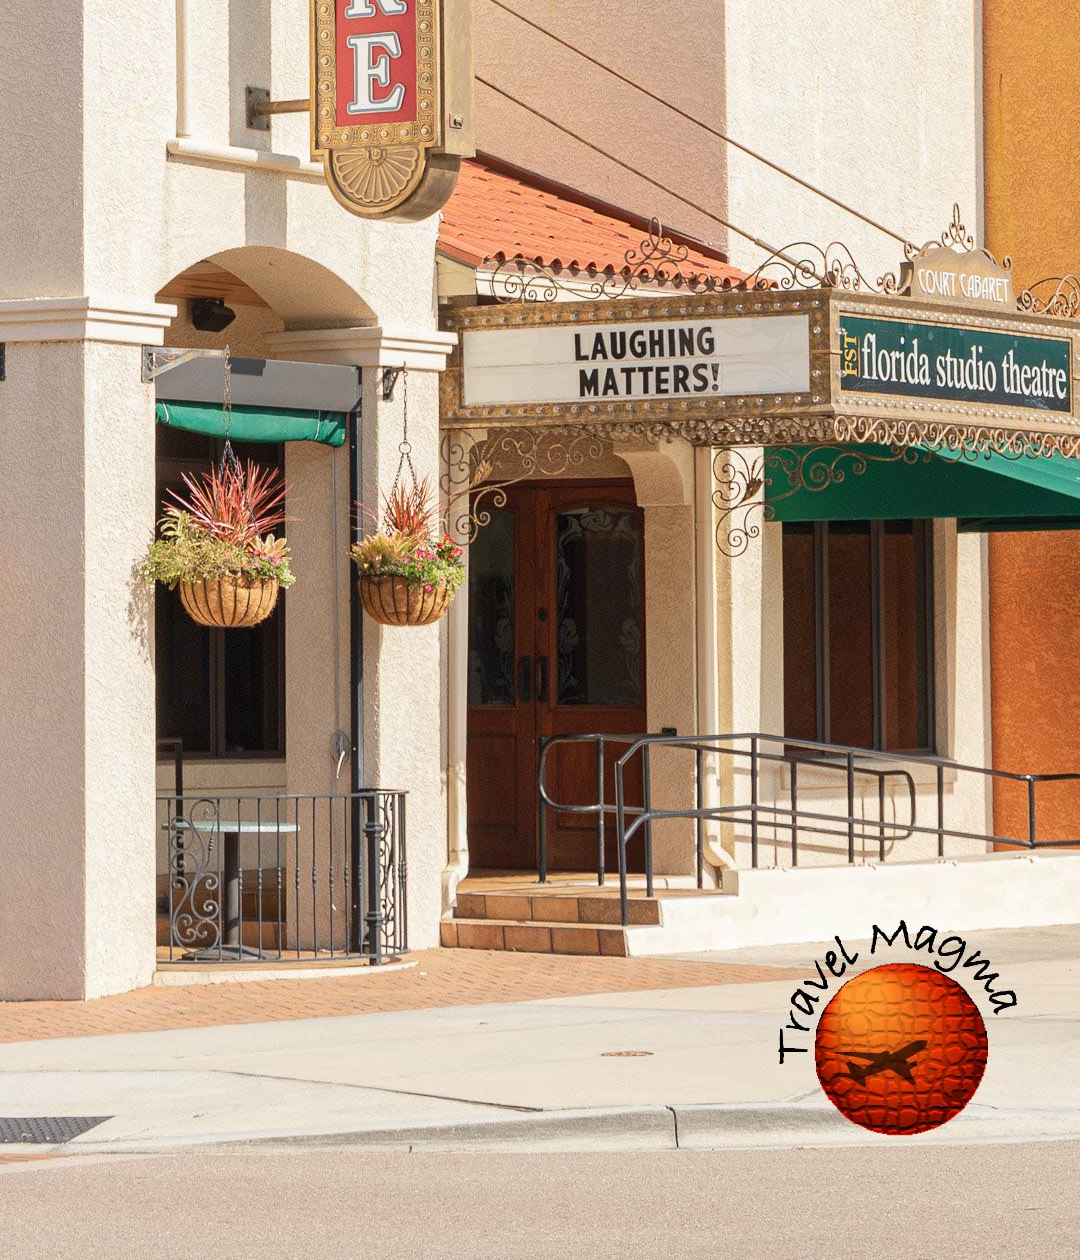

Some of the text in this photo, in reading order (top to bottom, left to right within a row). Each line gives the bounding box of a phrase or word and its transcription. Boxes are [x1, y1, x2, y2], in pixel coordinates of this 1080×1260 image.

[918, 268, 1010, 303] COURT CABARET
[574, 326, 716, 361] LAUGHING
[843, 332, 858, 377] FST
[578, 363, 721, 397] MATTERS!
[862, 333, 1068, 400] florida studio theatre
